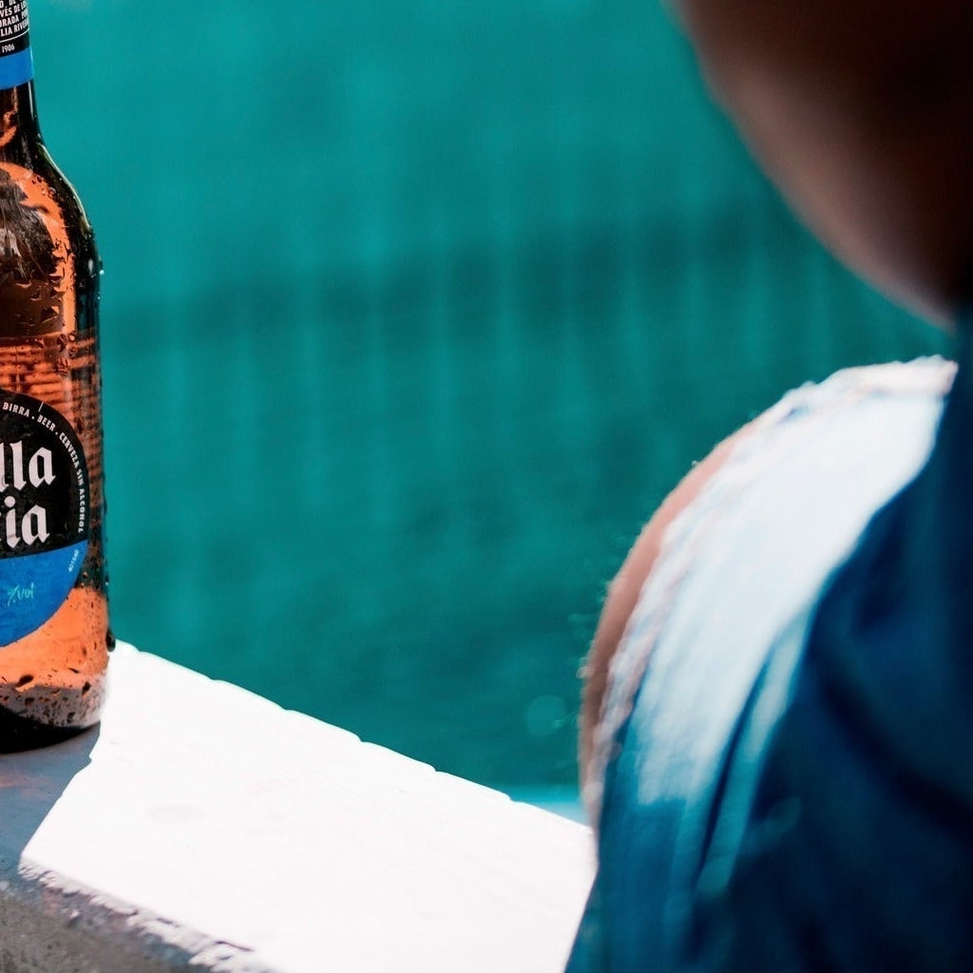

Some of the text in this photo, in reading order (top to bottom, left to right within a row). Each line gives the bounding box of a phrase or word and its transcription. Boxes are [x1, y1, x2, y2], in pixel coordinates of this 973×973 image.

[13, 5, 21, 14] DE
[2, 402, 30, 417] BIRRA
[37, 414, 56, 432] BEER
[59, 432, 80, 469] CERVEZA
[76, 468, 84, 486] SIN
